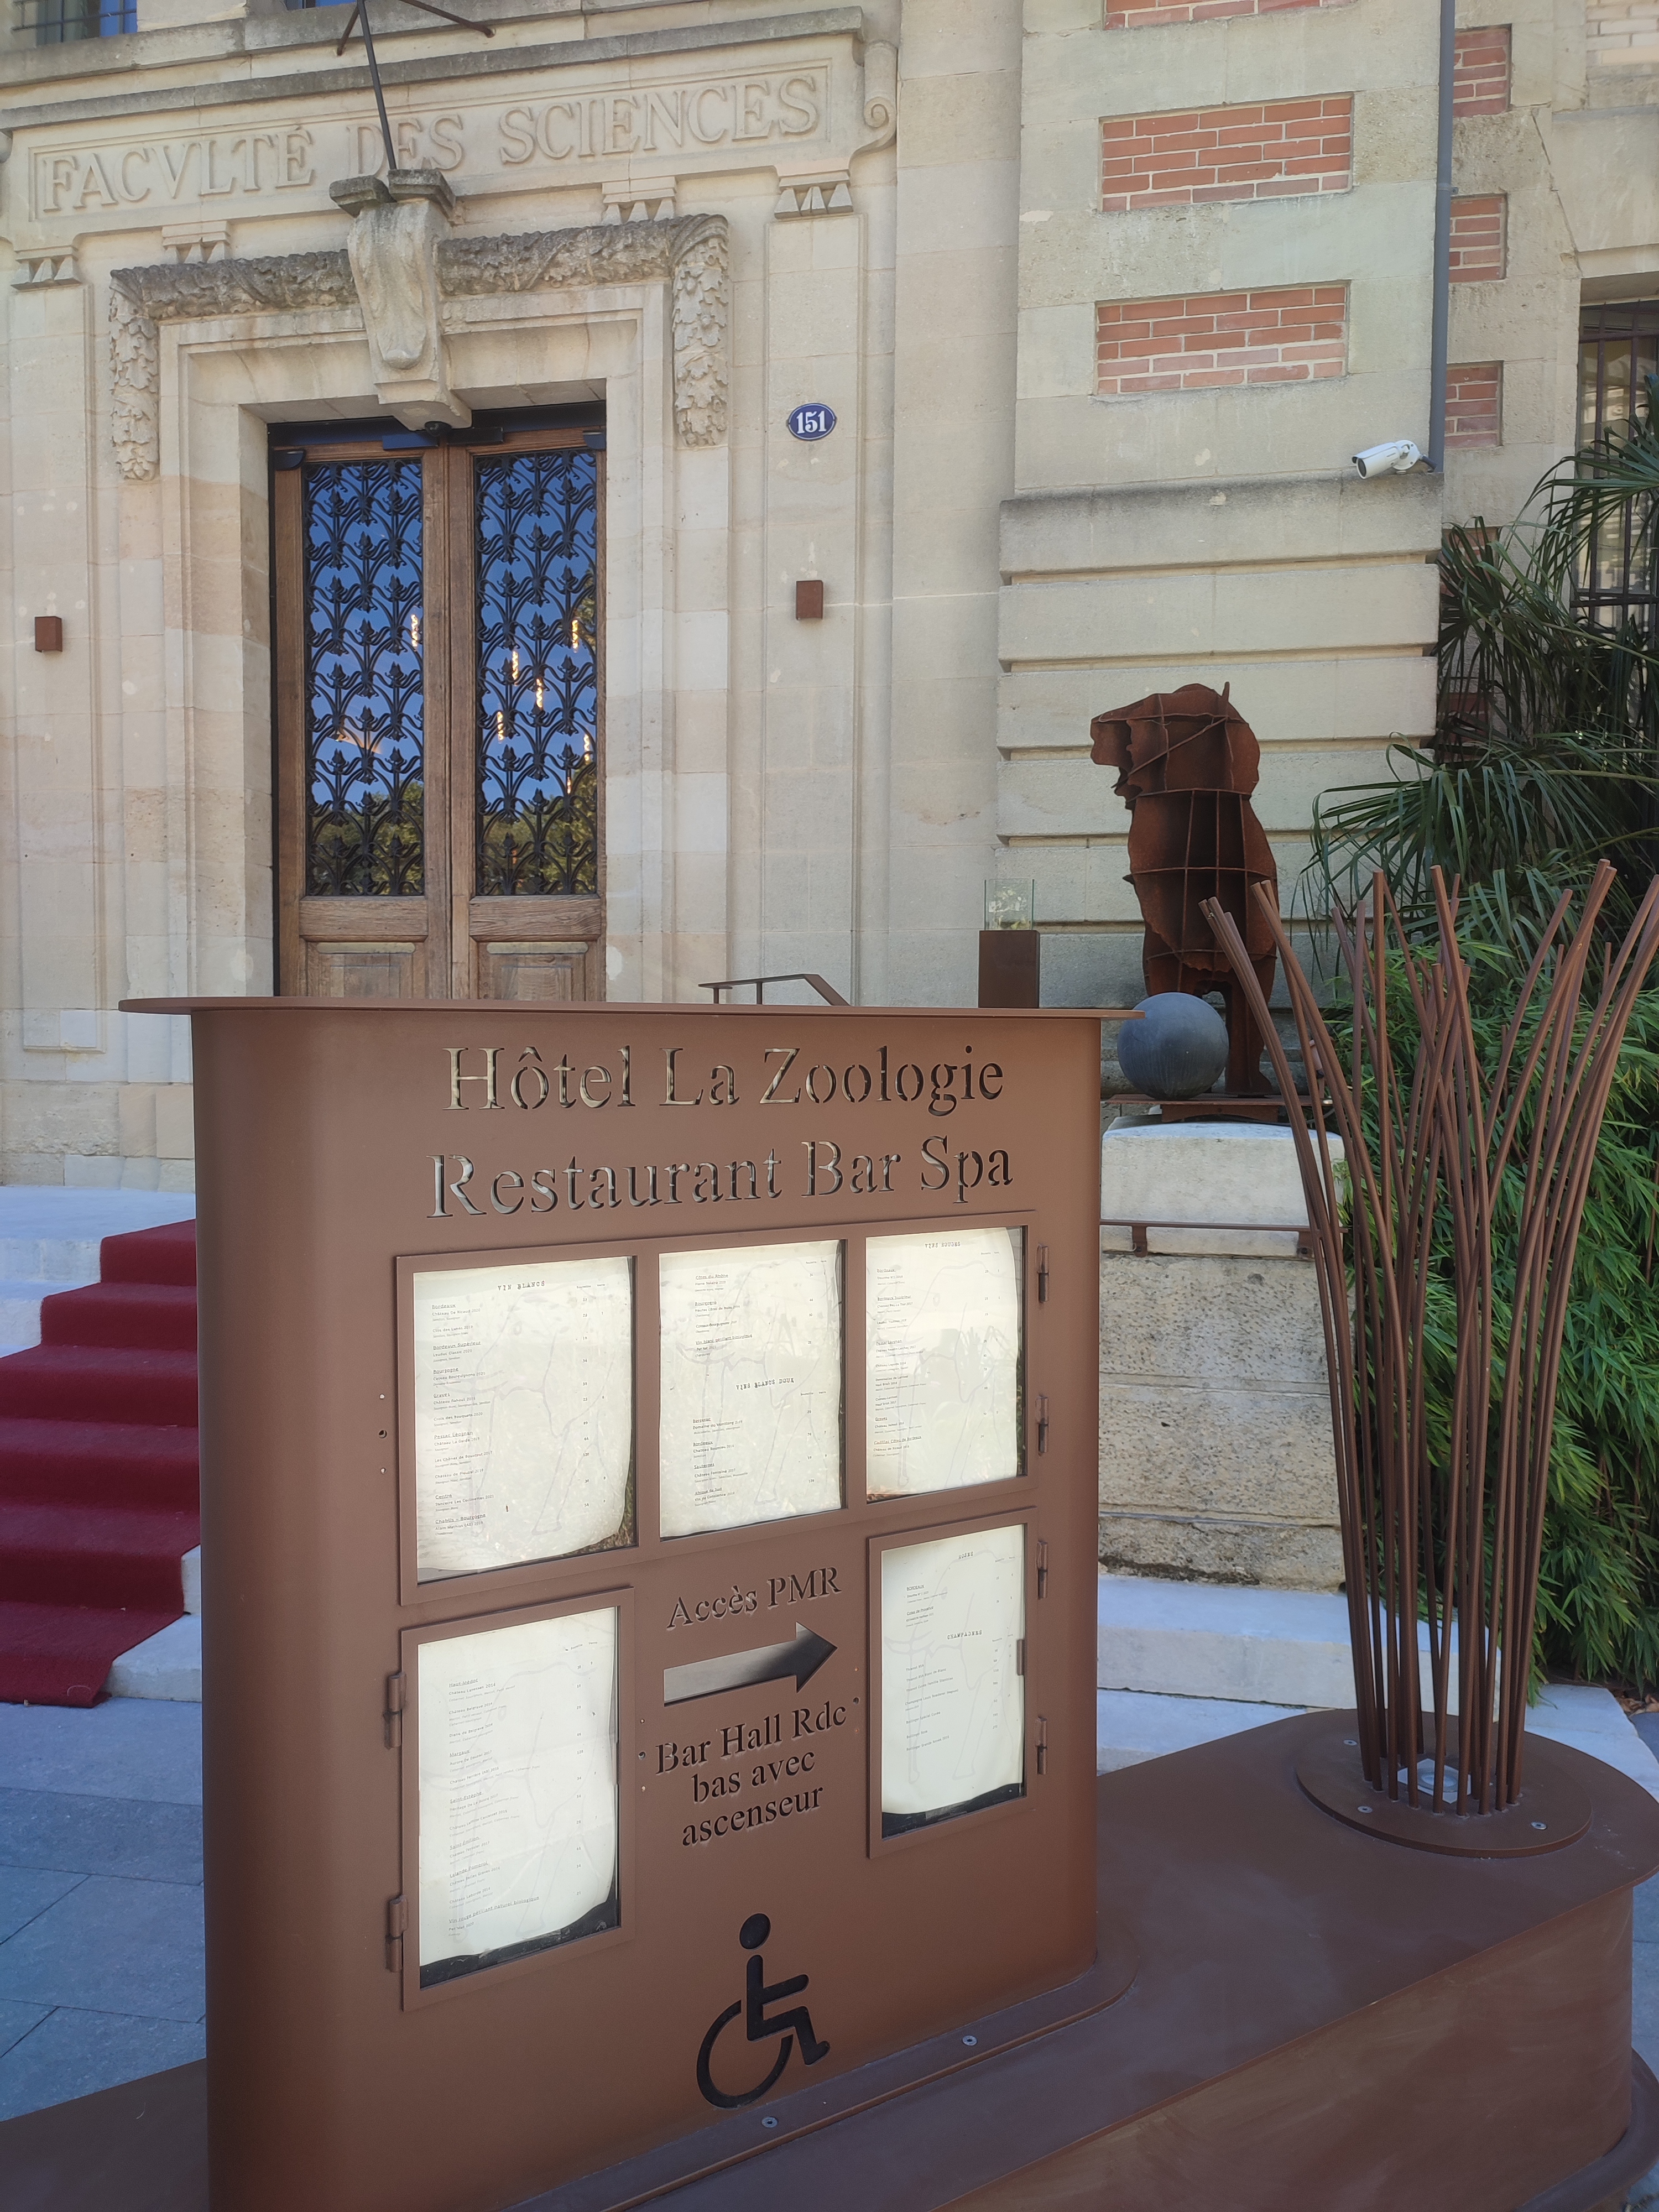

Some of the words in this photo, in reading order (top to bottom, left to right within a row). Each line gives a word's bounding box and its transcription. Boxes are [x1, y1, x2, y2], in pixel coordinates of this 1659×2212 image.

[42, 125, 315, 213] FACVLTÉ
[347, 114, 465, 178] DES
[499, 75, 818, 165] SCIENCES
[796, 411, 827, 434] 151
[442, 1046, 636, 1110] Hôtel
[659, 1048, 740, 1105] La
[759, 1045, 1003, 1117] Zoologie
[426, 1149, 782, 1218] Restaurant
[801, 1141, 901, 1197] Bar
[921, 1135, 1013, 1204] Spa
[667, 1585, 757, 1630] Accès
[768, 1566, 841, 1609] PMR
[656, 1740, 711, 1774] Bar
[721, 1713, 782, 1760] Hall
[792, 1701, 847, 1739] Rdc
[692, 1771, 740, 1803] bas
[751, 1751, 815, 1787] avec
[682, 1786, 823, 1846] ascenseur
